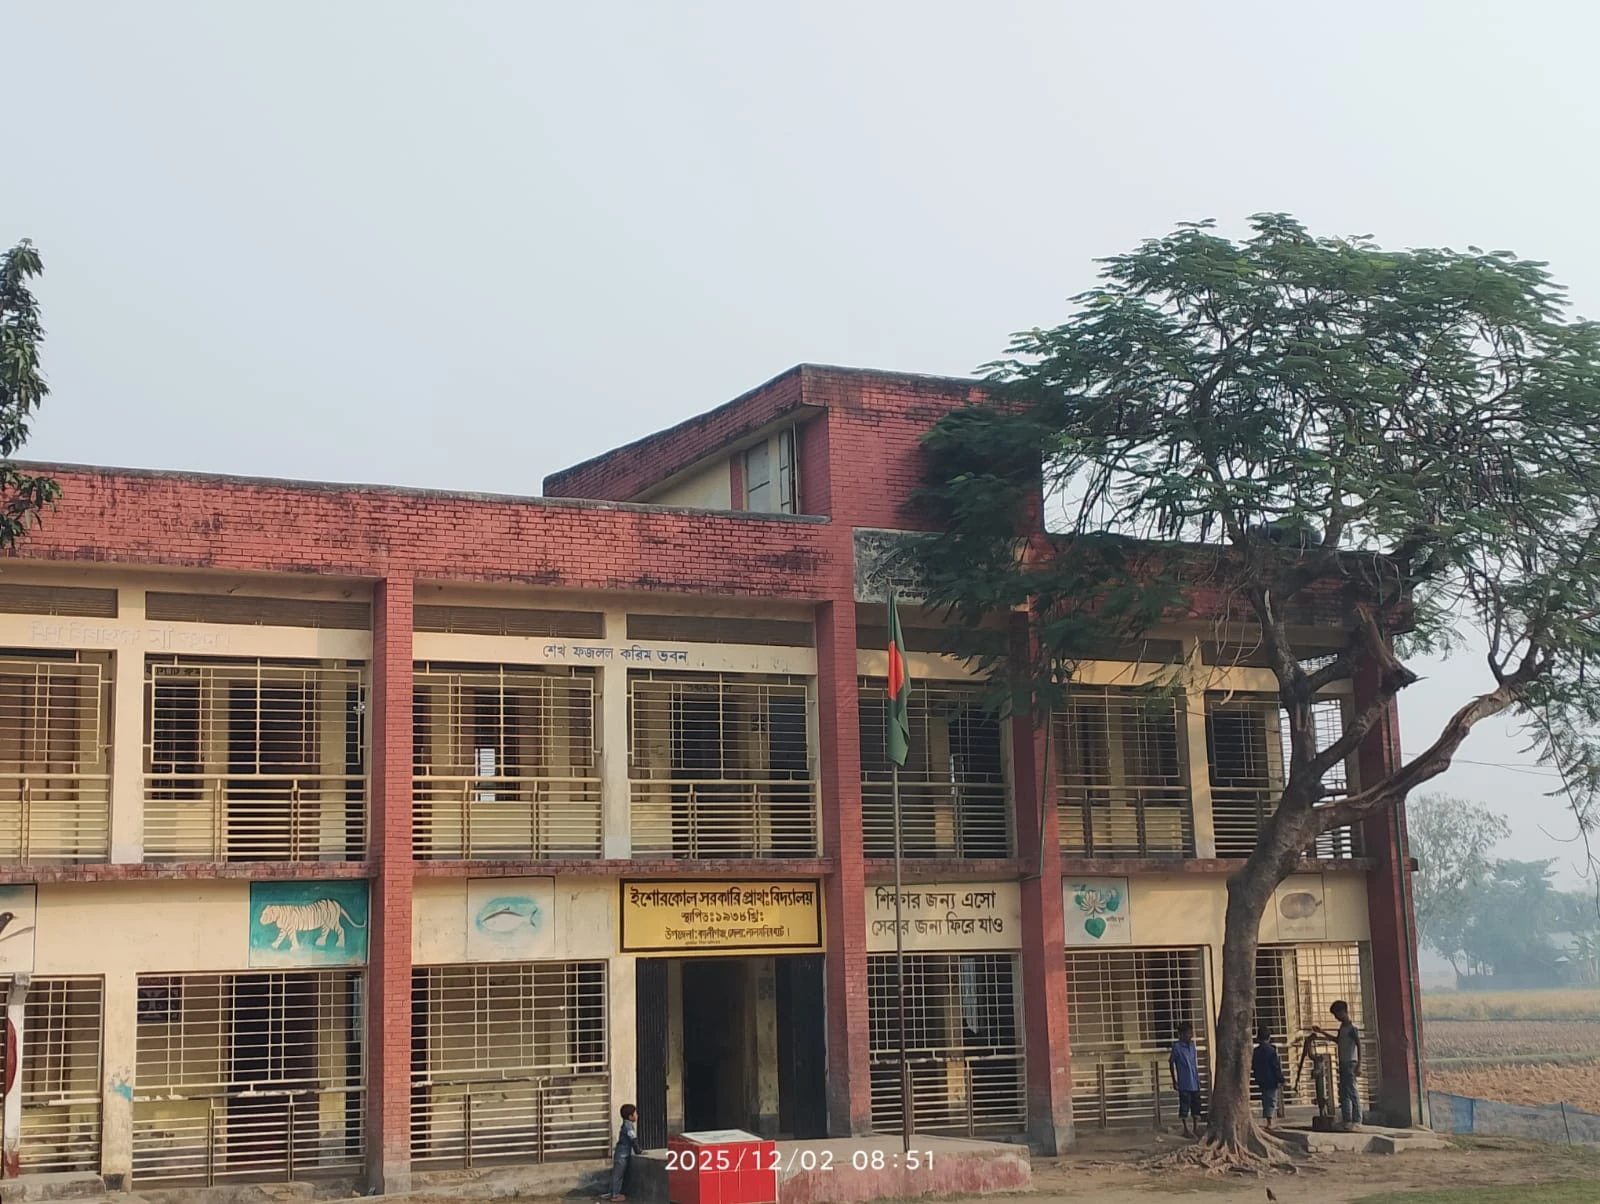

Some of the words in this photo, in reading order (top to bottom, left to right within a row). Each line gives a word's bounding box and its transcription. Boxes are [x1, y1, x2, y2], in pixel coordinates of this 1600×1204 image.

[542, 643, 567, 658] শেখ
[620, 644, 652, 661] করিম
[657, 649, 688, 663] ভবন
[926, 892, 956, 910] জন্য
[961, 889, 997, 909] এসো
[945, 911, 976, 935] ফিরে
[978, 915, 1003, 934] যাও
